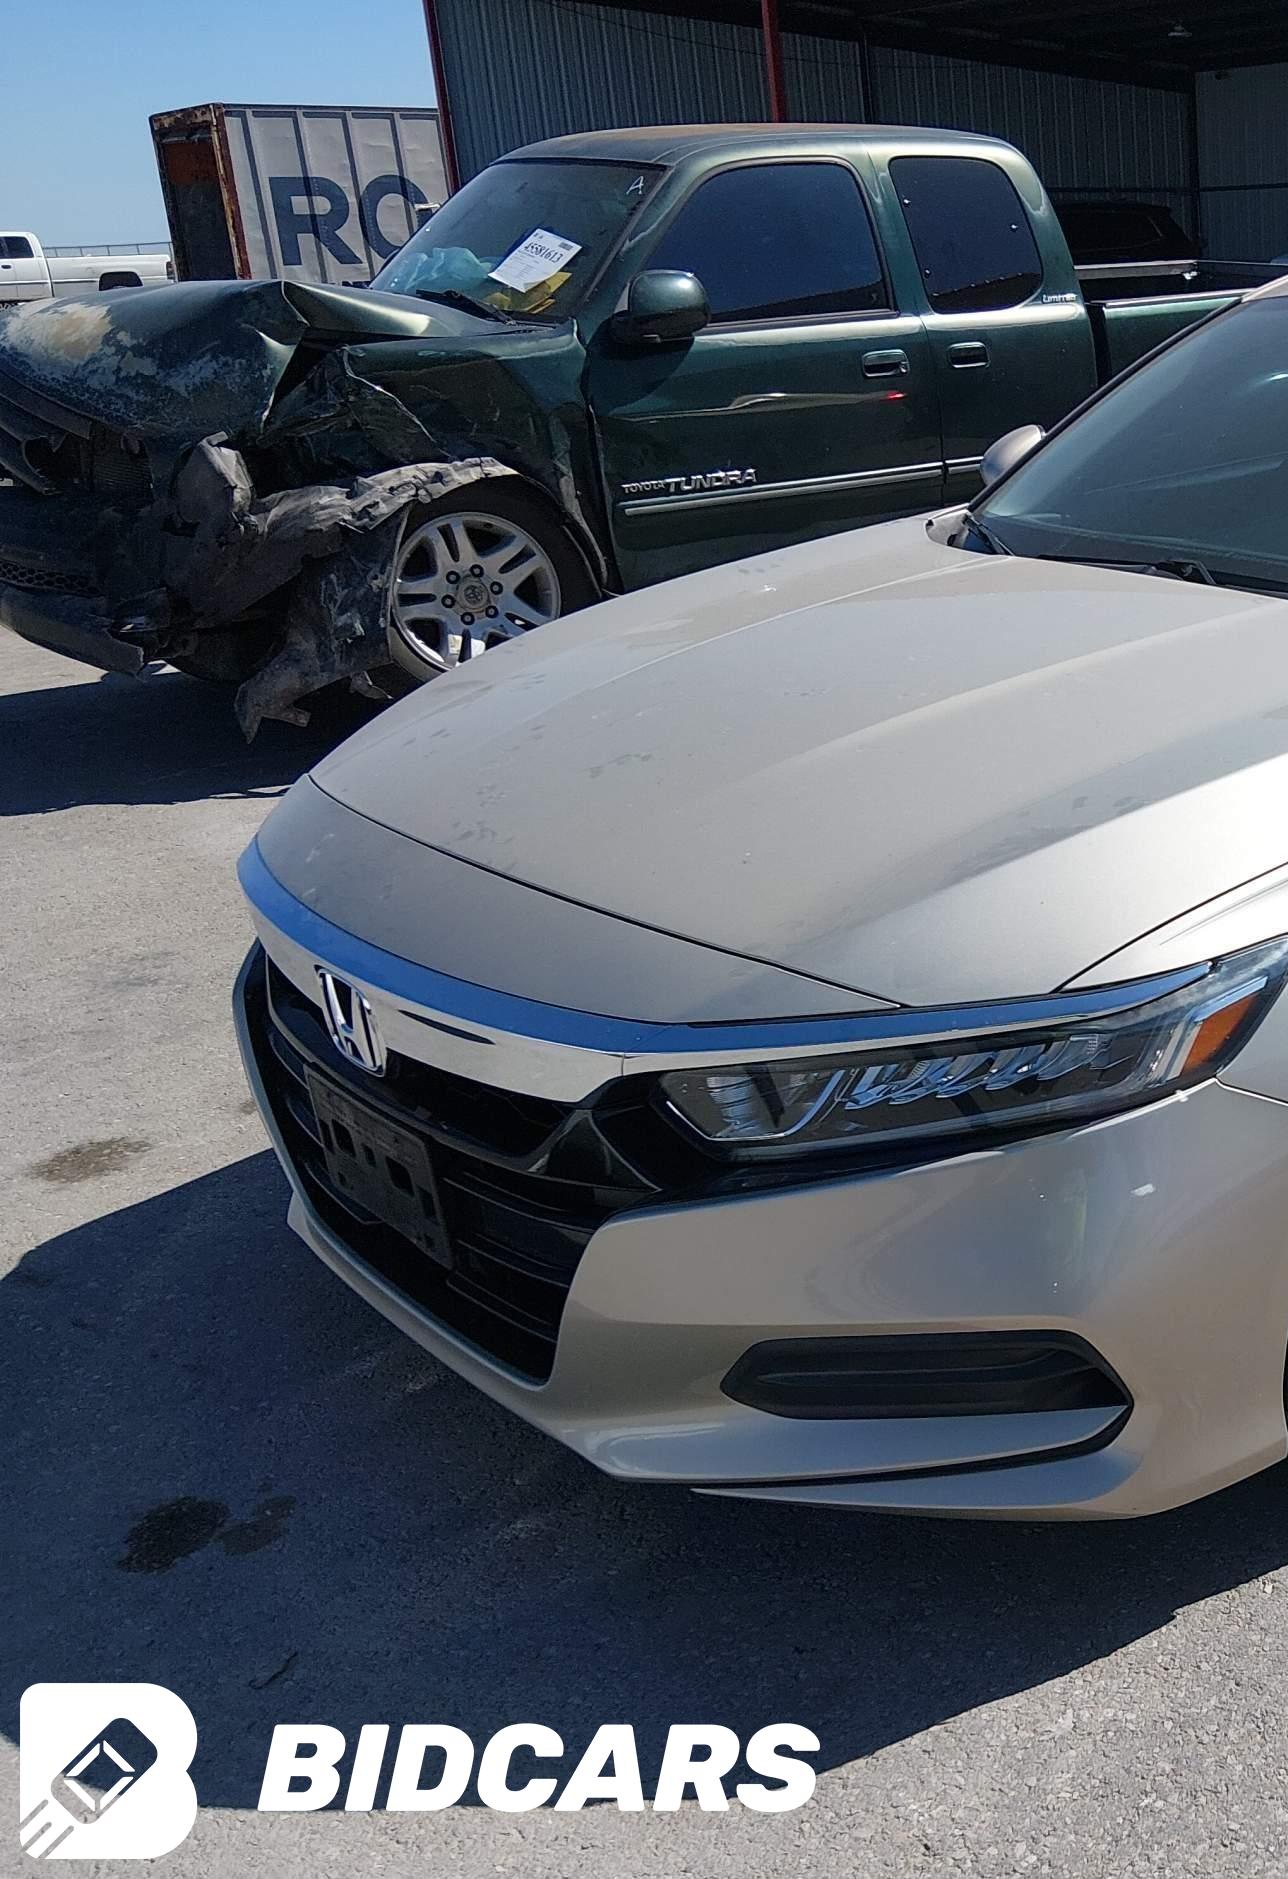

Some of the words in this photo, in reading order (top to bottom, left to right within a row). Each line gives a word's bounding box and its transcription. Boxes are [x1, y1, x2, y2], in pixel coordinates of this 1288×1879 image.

[626, 175, 645, 196] A
[621, 480, 665, 494] TOYOTA
[665, 468, 757, 493] TUNDRA
